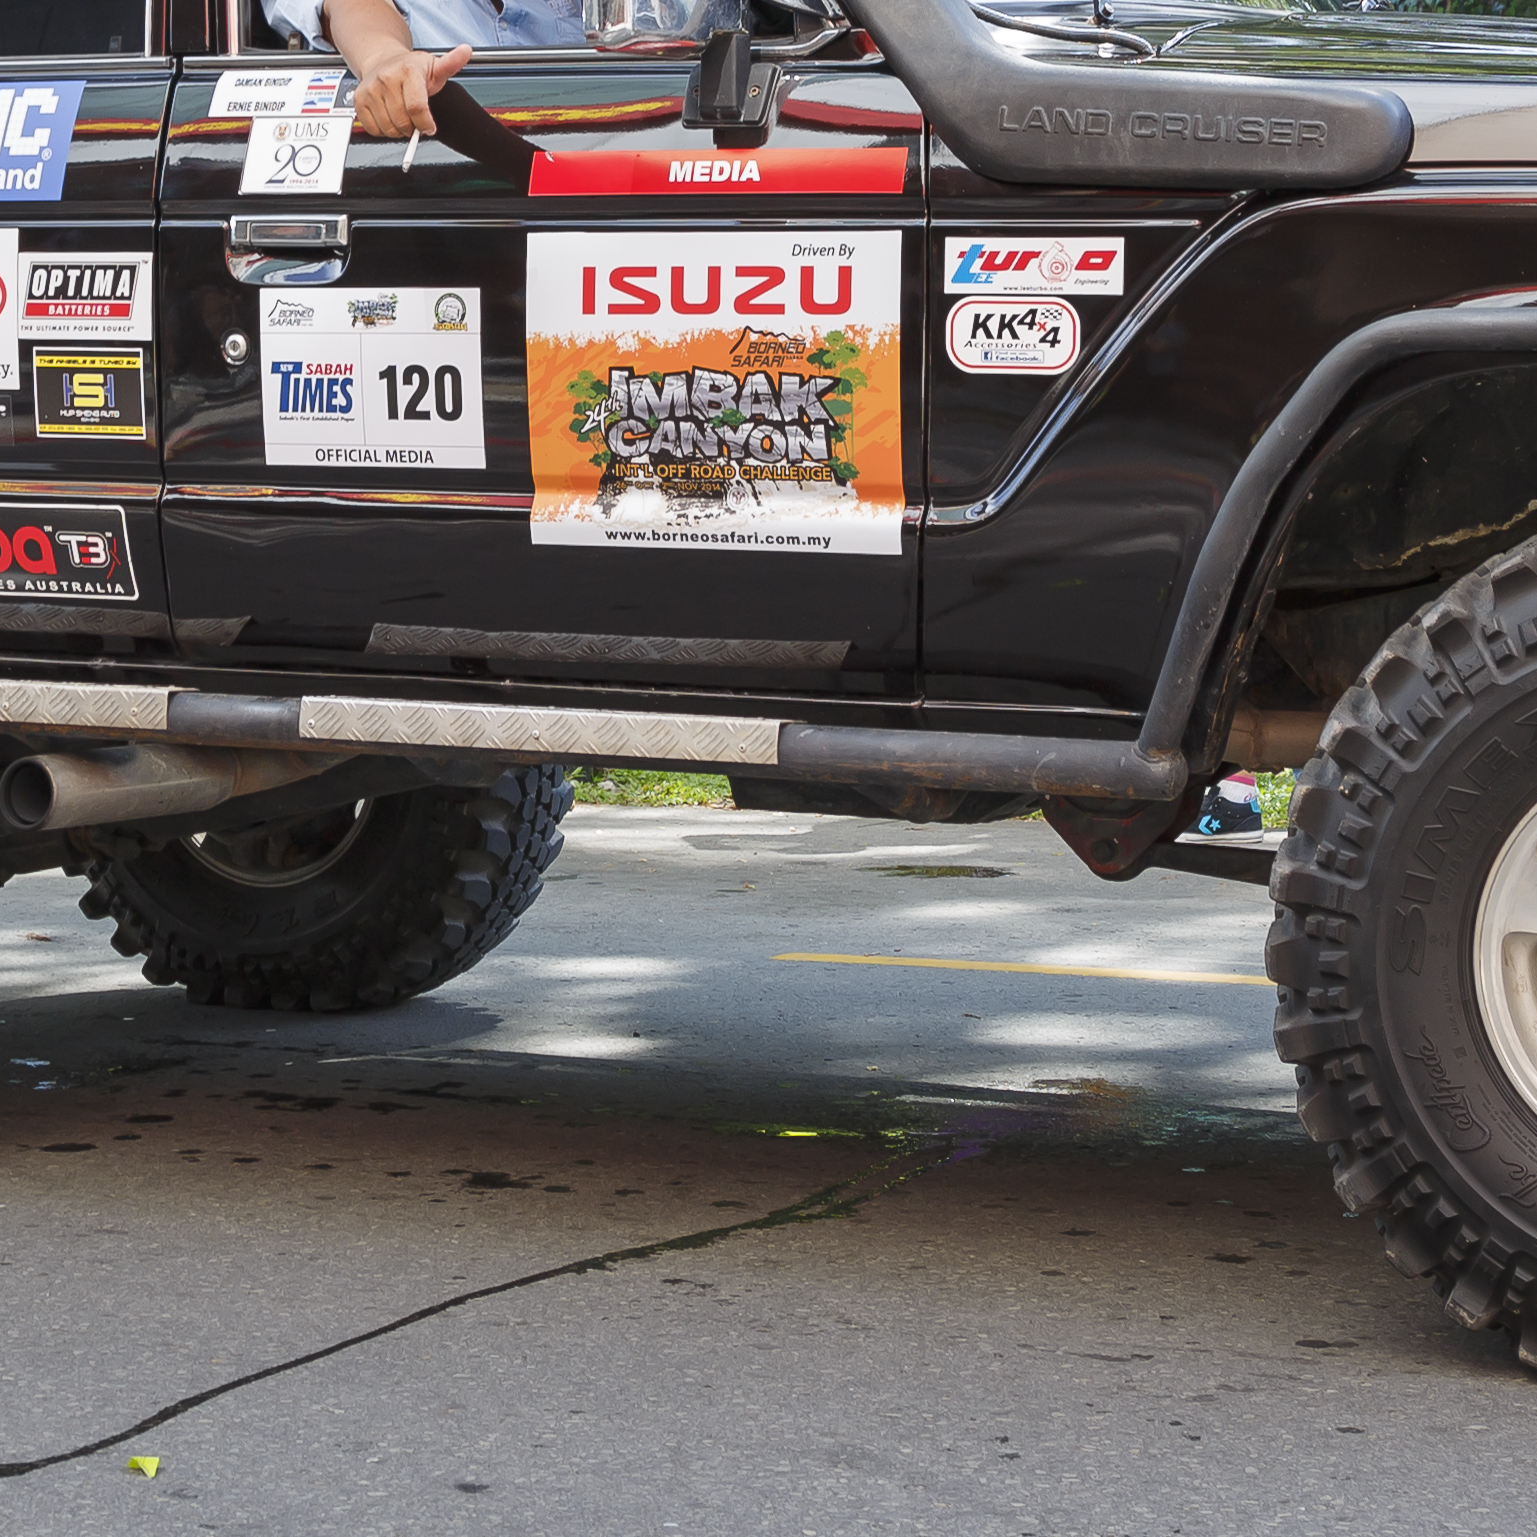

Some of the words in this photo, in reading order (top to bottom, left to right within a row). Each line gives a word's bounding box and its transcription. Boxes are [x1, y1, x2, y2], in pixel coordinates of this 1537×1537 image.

[227, 102, 252, 112] ERNIE
[254, 102, 286, 112] BINIDIP
[294, 122, 329, 138] UMS
[998, 105, 1113, 137] LAND
[1129, 111, 1328, 149] CRUISER
[668, 160, 761, 183] MEDIA
[791, 243, 835, 257] Driven
[838, 243, 855, 259] By
[31, 268, 130, 297] OPTIMA
[582, 265, 852, 315] ISUZU
[48, 304, 110, 316] BATTERIES
[279, 310, 314, 318] BORNEO
[270, 318, 301, 327] SAFARI
[747, 342, 806, 354] BORNEO
[964, 340, 1037, 349] Accessories
[279, 364, 294, 372] NEW
[306, 364, 353, 375] SABAH
[731, 356, 785, 368] SAFARI
[271, 361, 353, 413] TIMES
[379, 365, 463, 421] 120
[610, 367, 838, 426] IMBAK
[580, 391, 622, 433] 24th
[608, 418, 830, 464] CANYON
[315, 448, 381, 463] OFFICIAL
[385, 449, 434, 463] MEDIA
[615, 464, 652, 477] INT'L
[657, 464, 688, 478] OFF
[690, 464, 735, 479] ROAD
[740, 465, 832, 481] CHALLENGE
[701, 483, 720, 491] 2014
[605, 529, 832, 549] www.borneosafari.com.my
[57, 532, 109, 566] T3
[25, 579, 125, 594] AUSTRALIA
